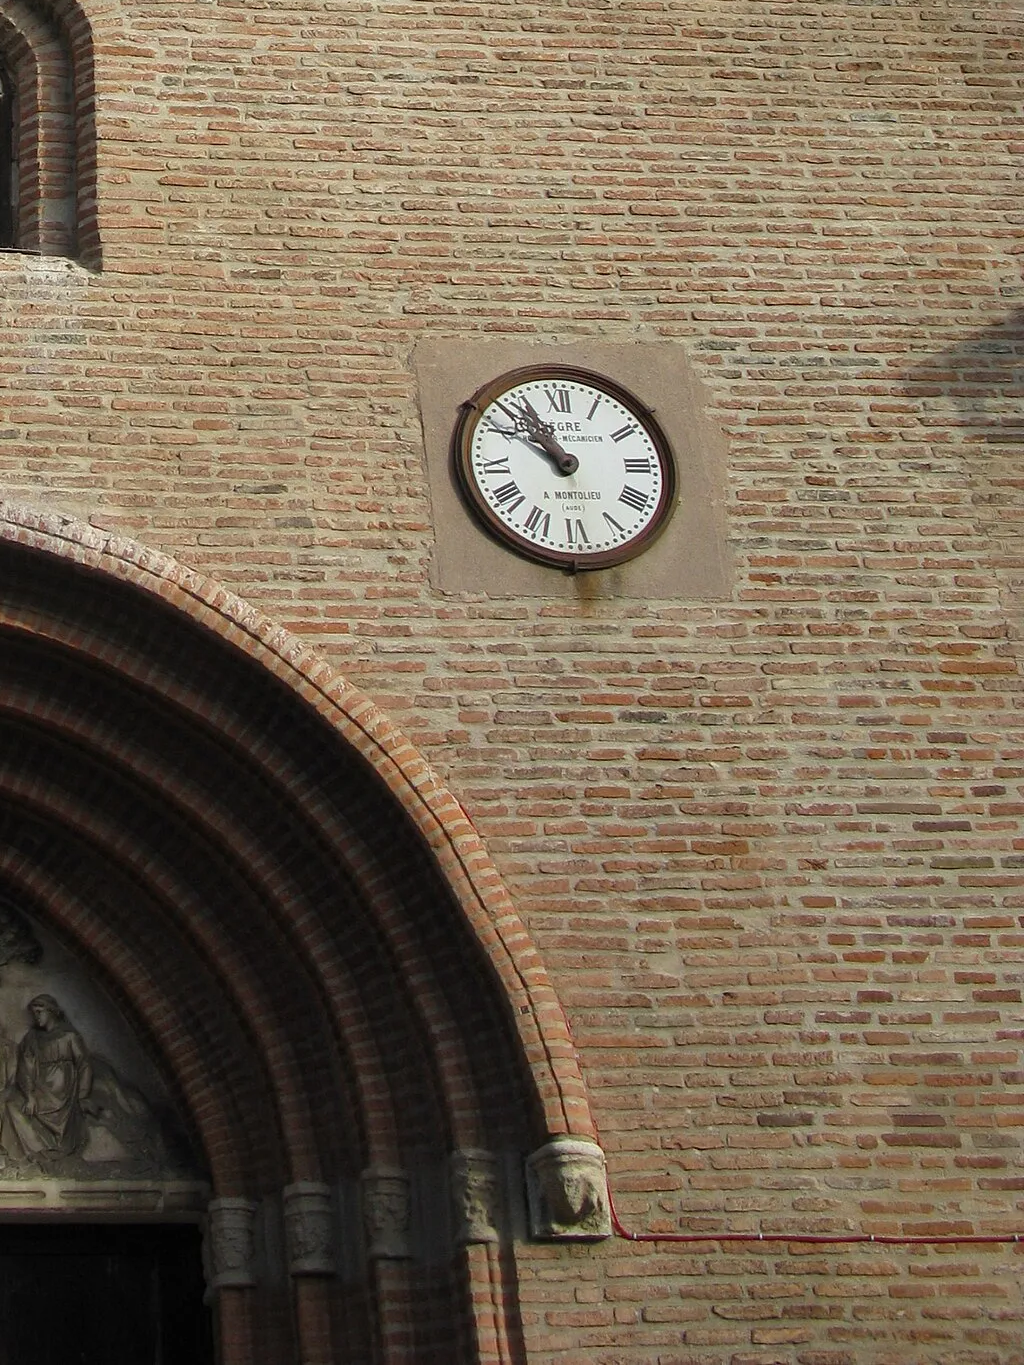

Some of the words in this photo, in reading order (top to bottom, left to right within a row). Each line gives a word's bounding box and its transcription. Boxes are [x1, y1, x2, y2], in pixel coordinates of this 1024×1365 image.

[543, 389, 572, 414] XII
[586, 398, 601, 421] I
[609, 423, 636, 443] II
[482, 457, 512, 475] IX
[623, 457, 652, 474] III
[492, 480, 527, 515] VIII
[555, 490, 602, 501] MONTOLIEU
[618, 484, 650, 513] IIII
[523, 505, 552, 538] VII
[565, 518, 591, 544] VI
[602, 511, 626, 537] V
